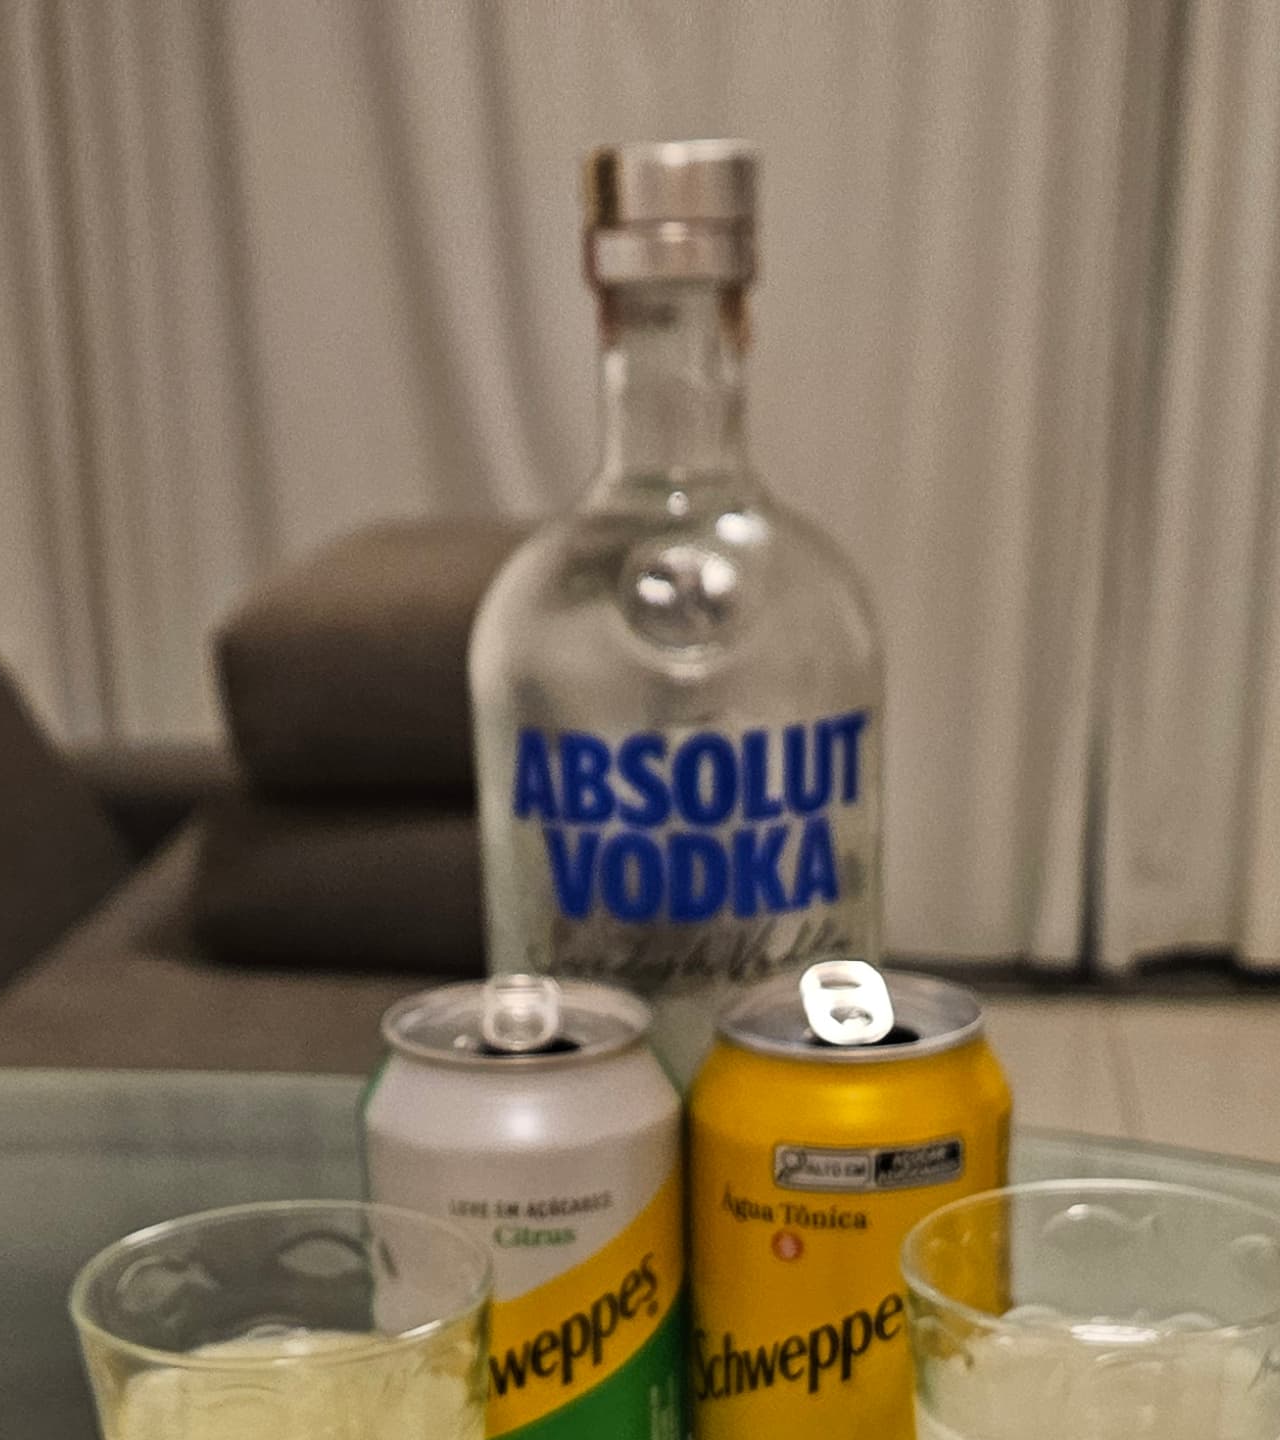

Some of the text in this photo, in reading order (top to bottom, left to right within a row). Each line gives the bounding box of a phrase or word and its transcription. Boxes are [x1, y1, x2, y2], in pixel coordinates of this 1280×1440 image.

[513, 711, 867, 825] ABSOLUT
[546, 814, 841, 925] VODKA
[493, 1223, 577, 1249] Citrus
[488, 1251, 660, 1397] weppes
[694, 1292, 905, 1401] Schweppe
